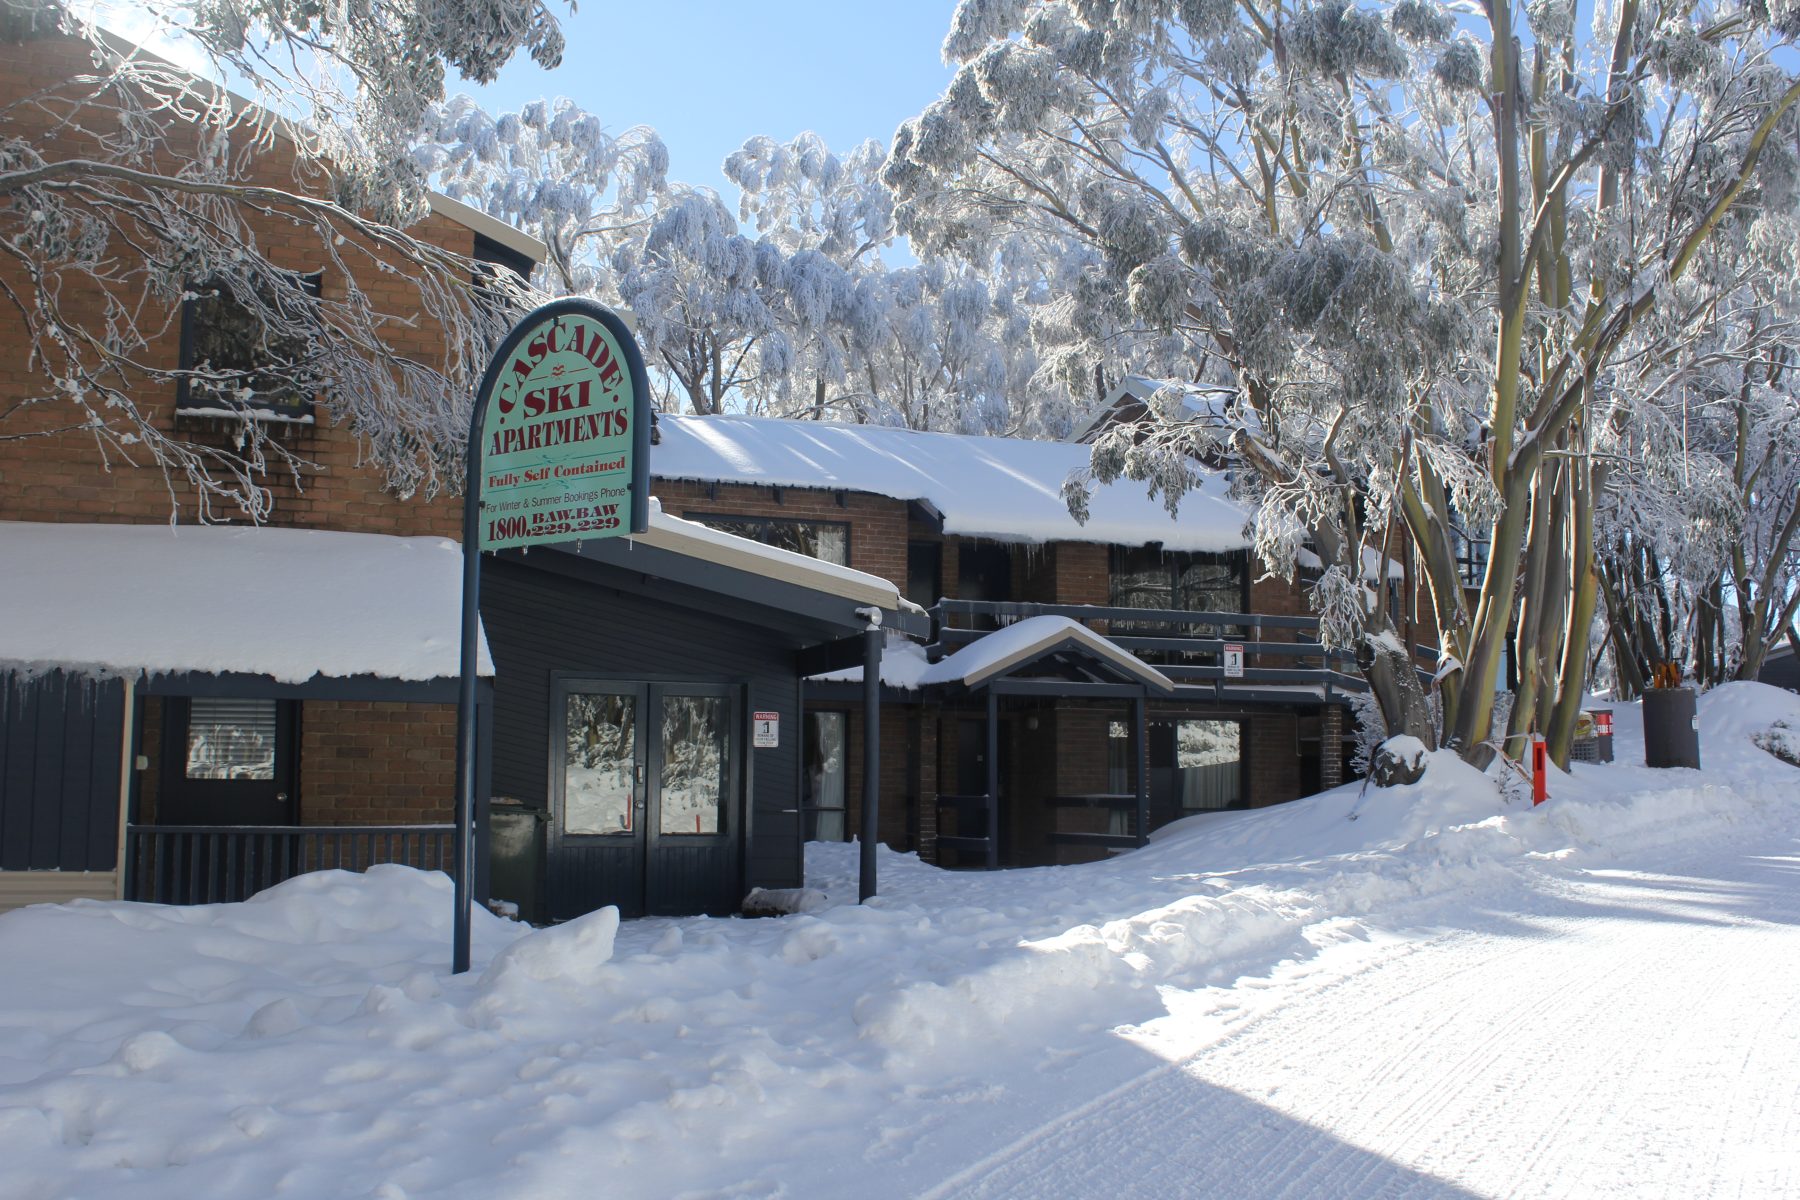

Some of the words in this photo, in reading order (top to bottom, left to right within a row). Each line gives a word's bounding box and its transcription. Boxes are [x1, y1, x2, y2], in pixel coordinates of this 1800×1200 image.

[498, 322, 624, 414] CASCADE
[523, 380, 592, 420] SKI
[488, 406, 628, 457] APARTMENTS
[489, 473, 520, 488] Fully
[523, 467, 551, 483] Self
[554, 456, 626, 478] Contained
[485, 503, 497, 513] For
[500, 500, 521, 511] Winter
[523, 498, 529, 508] &
[531, 496, 562, 508] Summer
[600, 487, 626, 498] Phone
[532, 503, 620, 525] BAW.BAW
